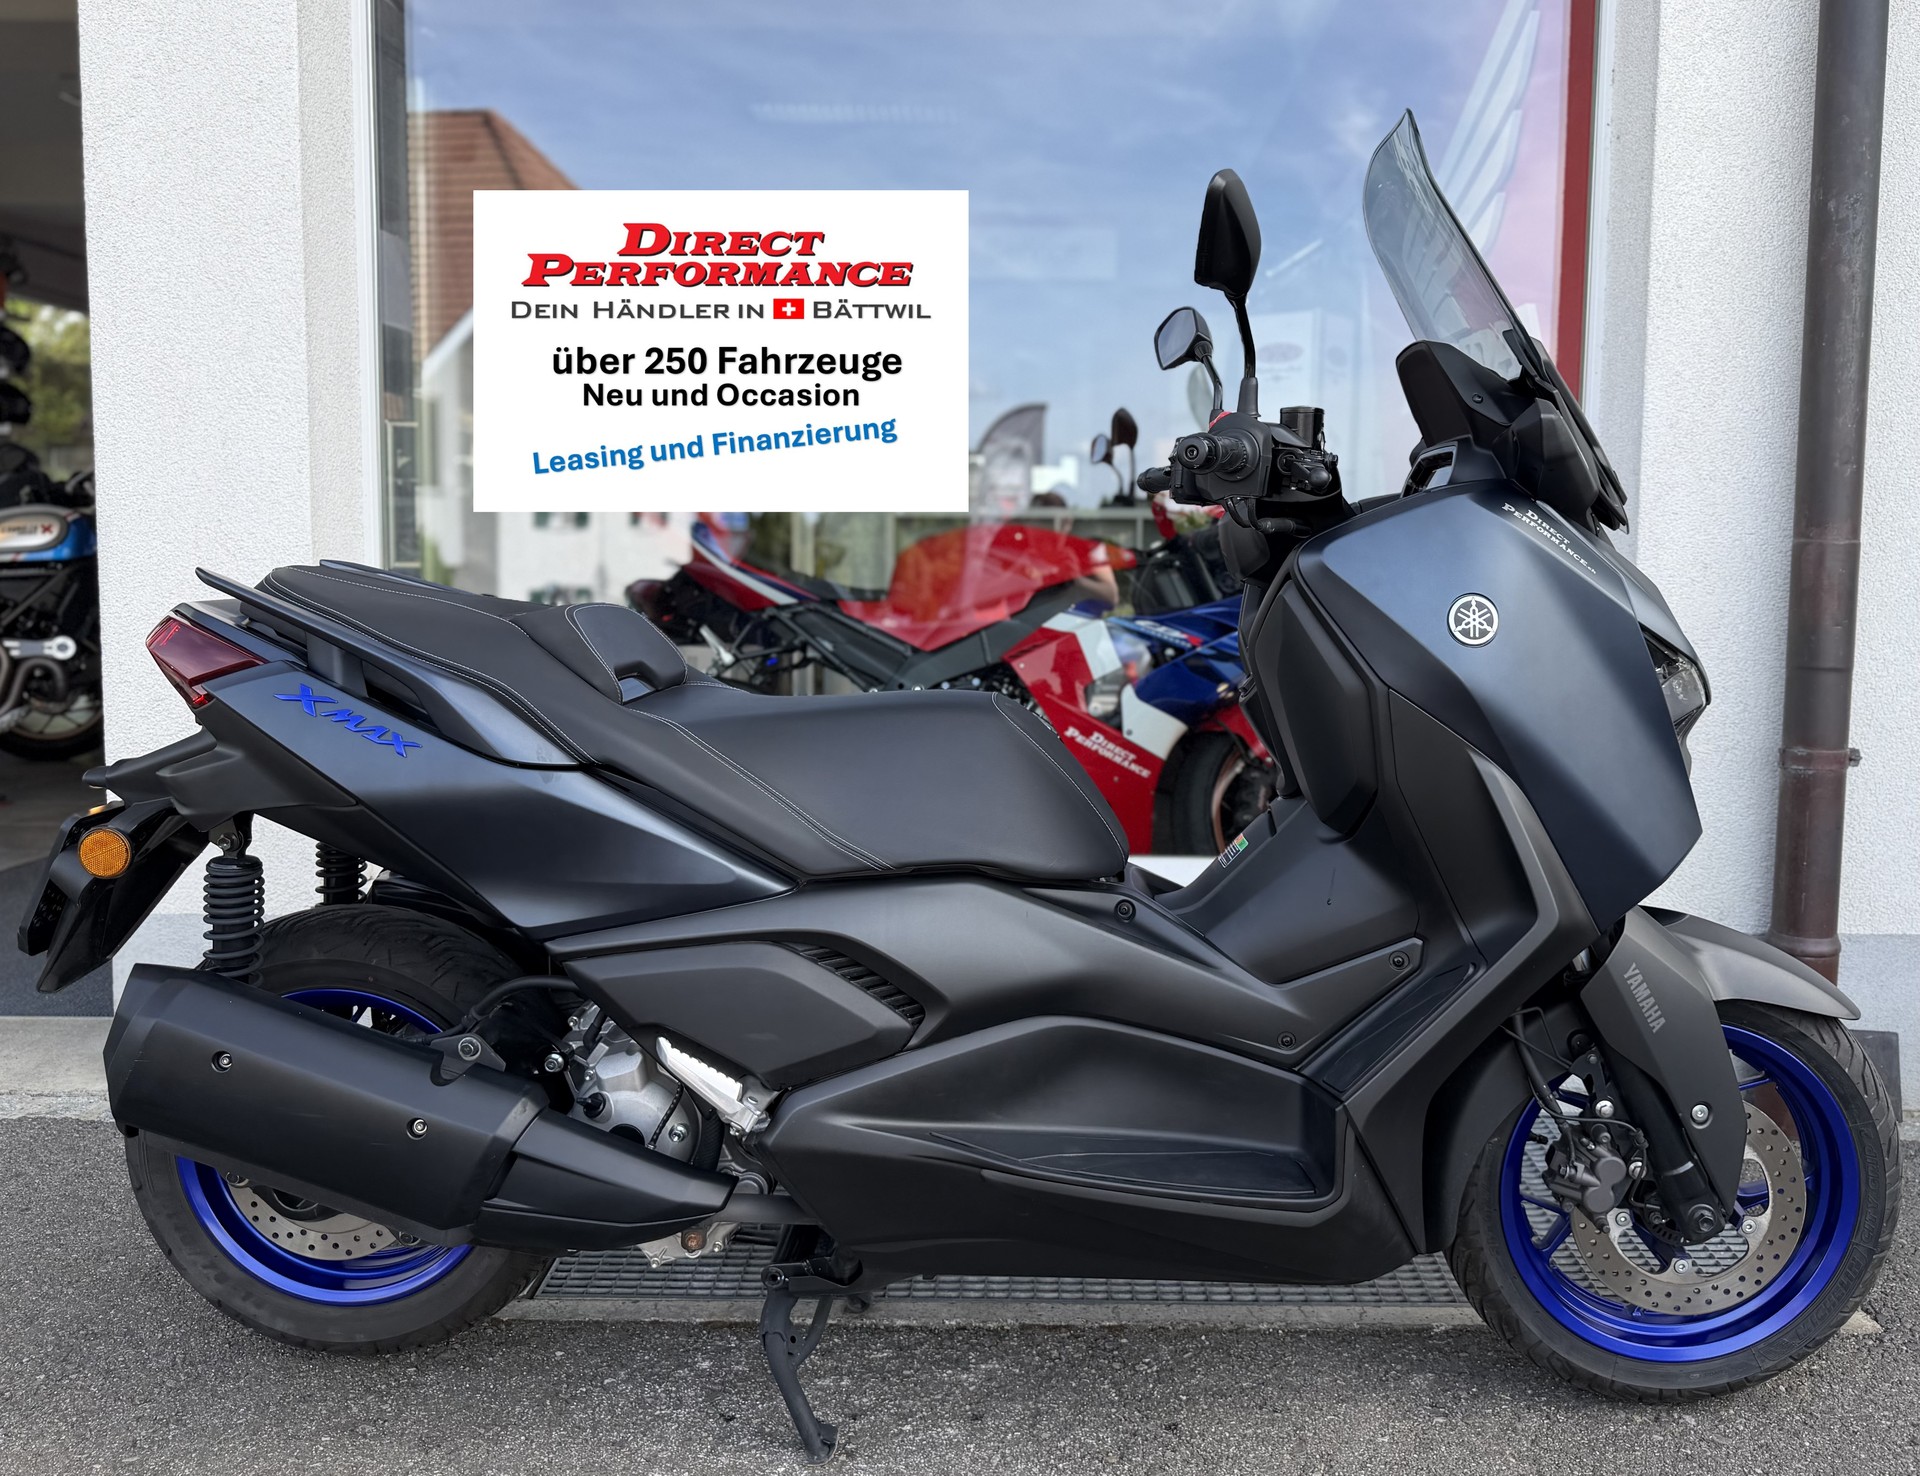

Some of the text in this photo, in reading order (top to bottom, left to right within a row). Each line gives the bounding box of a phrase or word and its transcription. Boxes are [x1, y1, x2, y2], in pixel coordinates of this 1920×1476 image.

[1526, 509, 1571, 545] DIRECT
[1064, 726, 1152, 779] PERFORMANCE
[1091, 731, 1137, 762] DIRECT
[1623, 962, 1666, 1034] YAMAHA
[1864, 1143, 1880, 1190] GRIP
[1860, 1194, 1881, 1245] CITY
